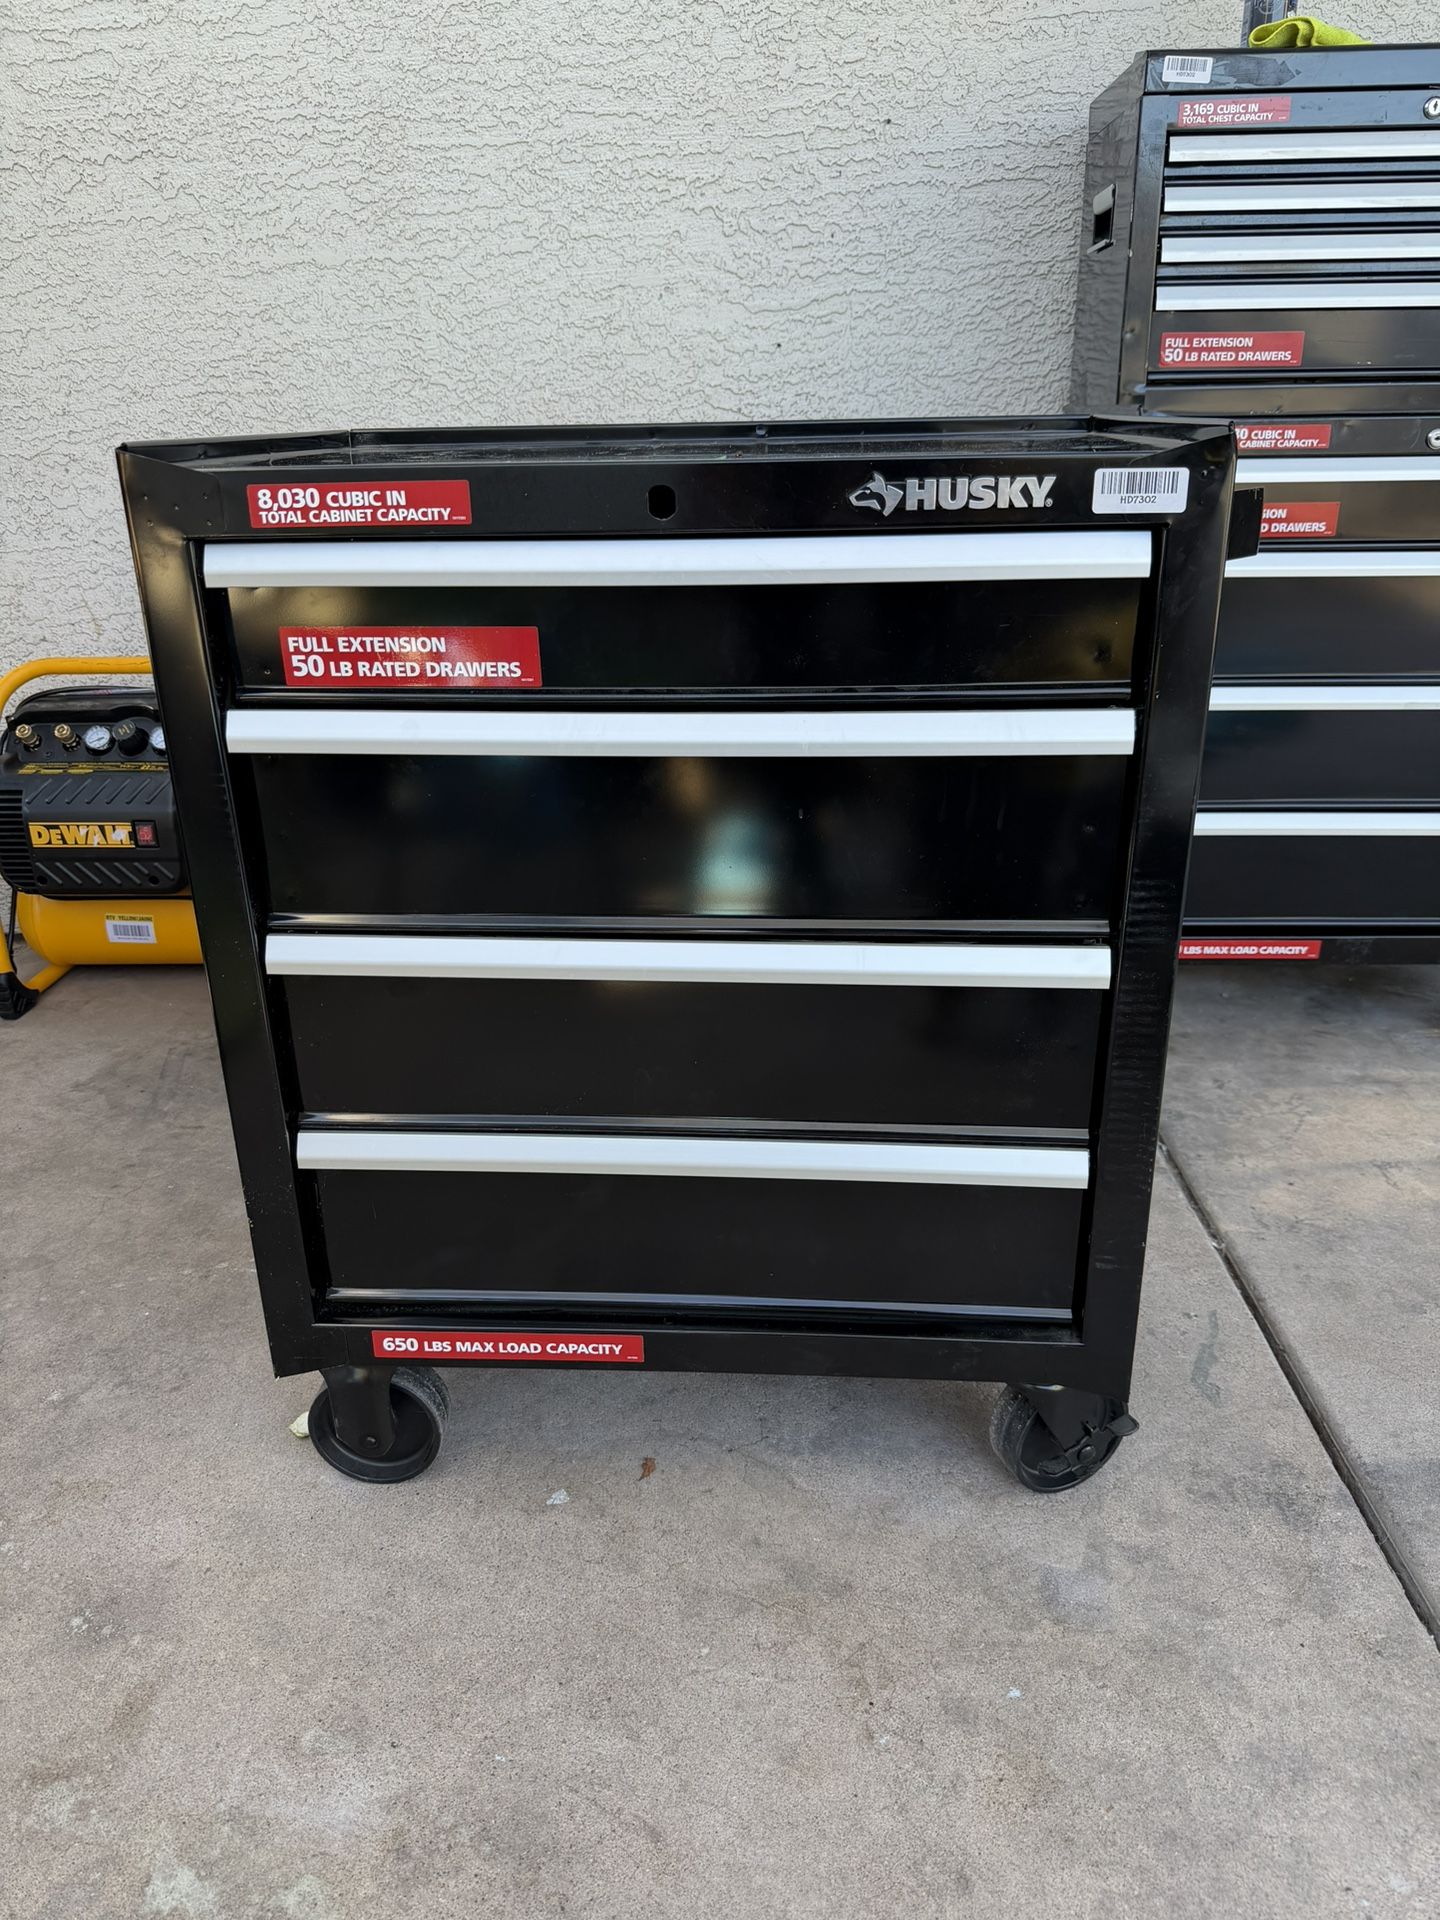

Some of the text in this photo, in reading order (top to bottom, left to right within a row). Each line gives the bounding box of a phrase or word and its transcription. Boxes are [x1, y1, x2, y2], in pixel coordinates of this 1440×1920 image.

[1183, 103, 1259, 116] 3,169 CUBIC IN
[1182, 116, 1207, 124] TOTAL
[1208, 115, 1233, 123] CHEST
[1234, 113, 1273, 122] CAPACITY
[1165, 337, 1253, 347] FULL EXTENSION
[1164, 349, 1292, 362] 50 LB RATED DRAWERS
[1251, 430, 1283, 439] CUBIC
[1284, 430, 1296, 439] IN
[1240, 439, 1319, 448] CABINET CAPACITY
[257, 488, 406, 511] 8,030 CUBIC IN
[906, 477, 1057, 511] HUSKY
[1120, 496, 1157, 504] HD7302
[259, 507, 451, 524] TOTAL CABINET CAPACITY
[1271, 522, 1326, 532] DRAWERS
[288, 636, 446, 653] FULL EXTENSION
[291, 655, 521, 678] 50 LB RATED DRAWERS
[1183, 946, 1202, 954] LBS
[1203, 946, 1229, 954] MAX
[1230, 946, 1258, 954] LOAD
[1259, 946, 1308, 954] CAPACITY
[383, 1337, 622, 1355] 650 LBS MAX LOAD CAPACITY
